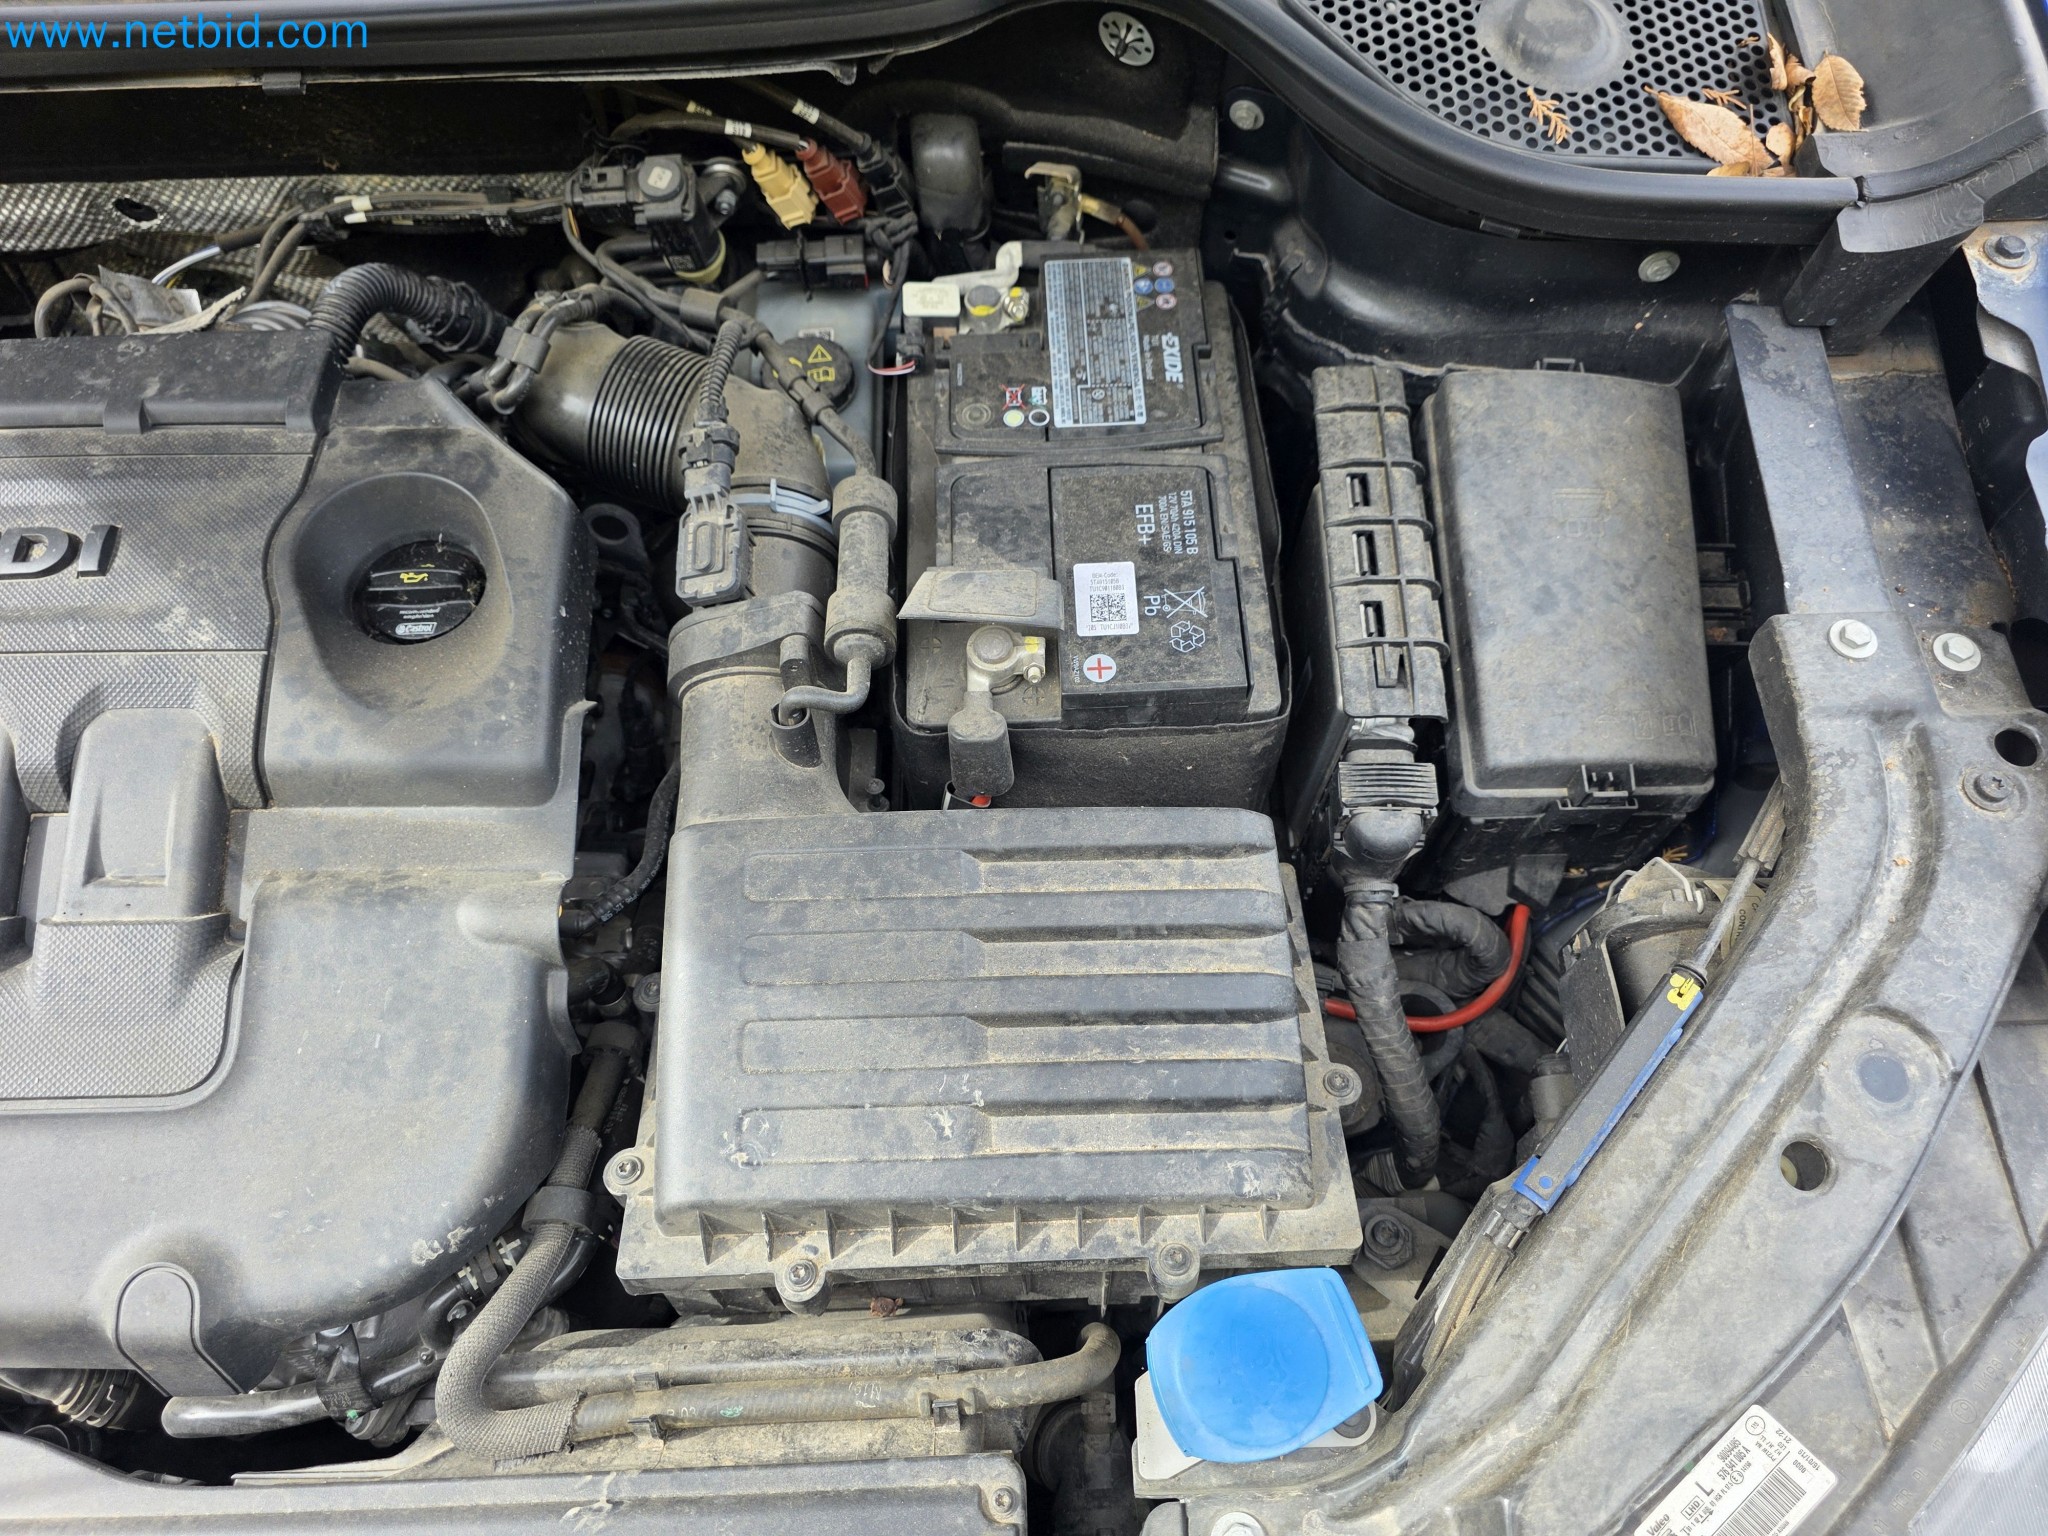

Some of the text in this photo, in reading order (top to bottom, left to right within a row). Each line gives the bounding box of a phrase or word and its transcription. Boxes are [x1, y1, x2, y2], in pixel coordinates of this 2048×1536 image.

[1161, 332, 1183, 383] EXIDE
[1180, 490, 1193, 508] 5TA
[1135, 504, 1155, 545] EFB+
[1182, 509, 1195, 526] 915
[1184, 528, 1197, 545] 105
[1173, 541, 1182, 554] DIN
[1143, 595, 1160, 615] Pb
[1696, 1481, 1714, 1496] L
[1684, 1501, 1700, 1516] LHD
[1646, 1514, 1670, 1536] Valeo
